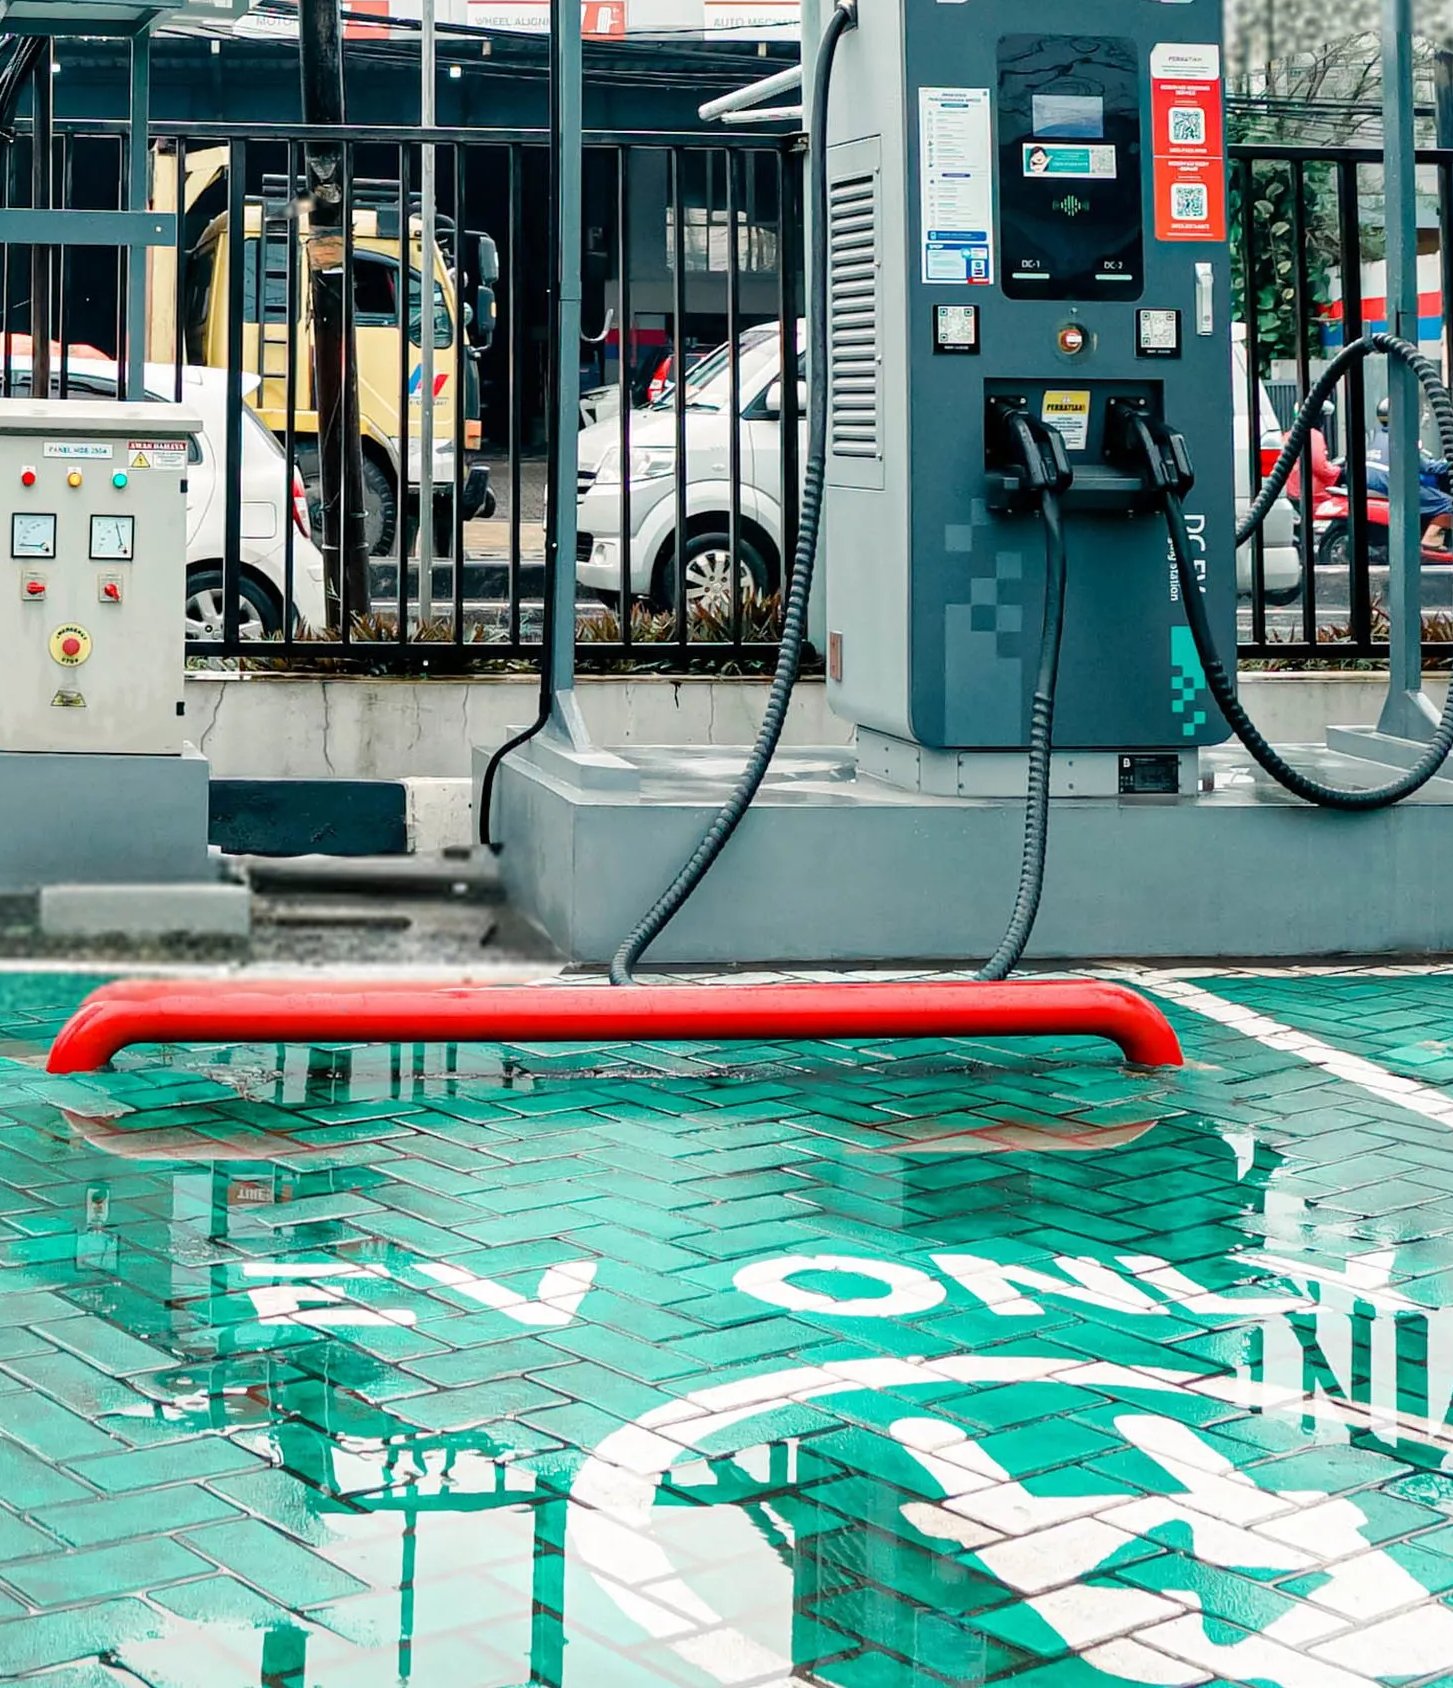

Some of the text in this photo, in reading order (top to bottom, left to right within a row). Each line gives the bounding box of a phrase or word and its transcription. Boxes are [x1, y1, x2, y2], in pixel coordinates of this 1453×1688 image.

[514, 16, 550, 26] ALIGN
[242, 1254, 1440, 1328] EV ONLY
